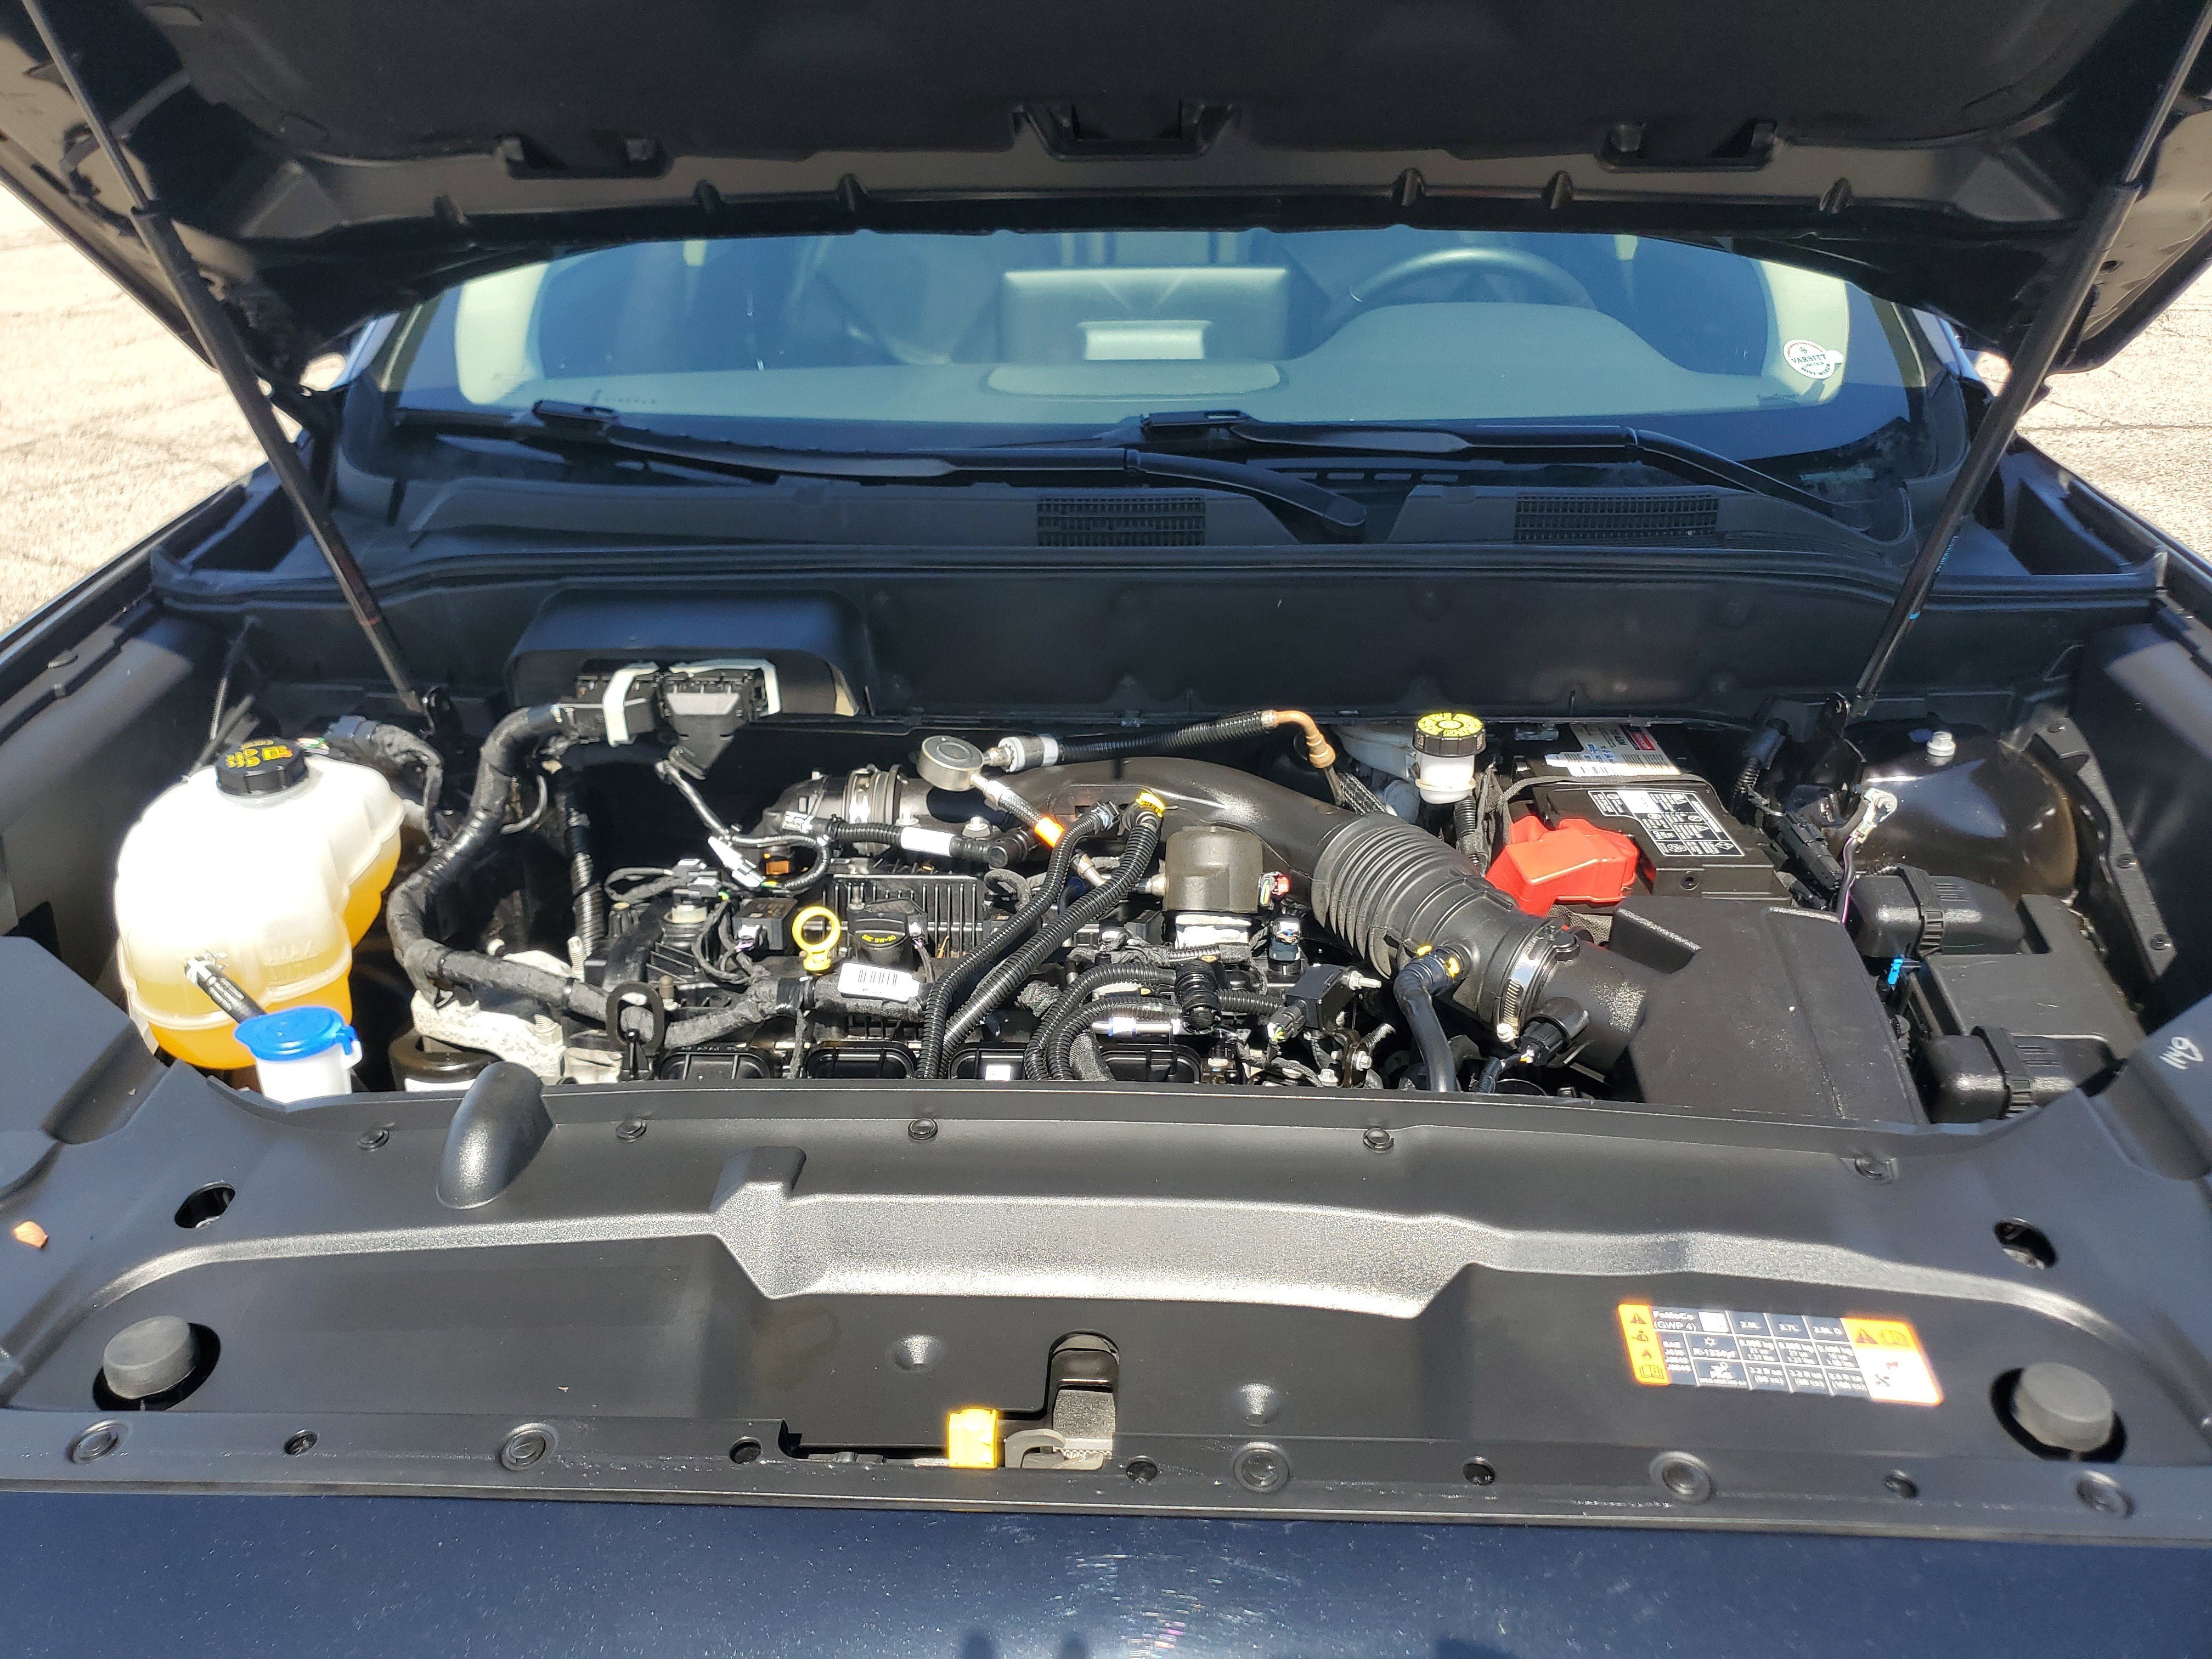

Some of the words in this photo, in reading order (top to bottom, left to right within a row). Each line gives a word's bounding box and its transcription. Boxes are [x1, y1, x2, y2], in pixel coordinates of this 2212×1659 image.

[1791, 354, 1826, 363] VARSITY
[1654, 1321, 1684, 1330] (GWP
[1686, 1322, 1697, 1331] 4)
